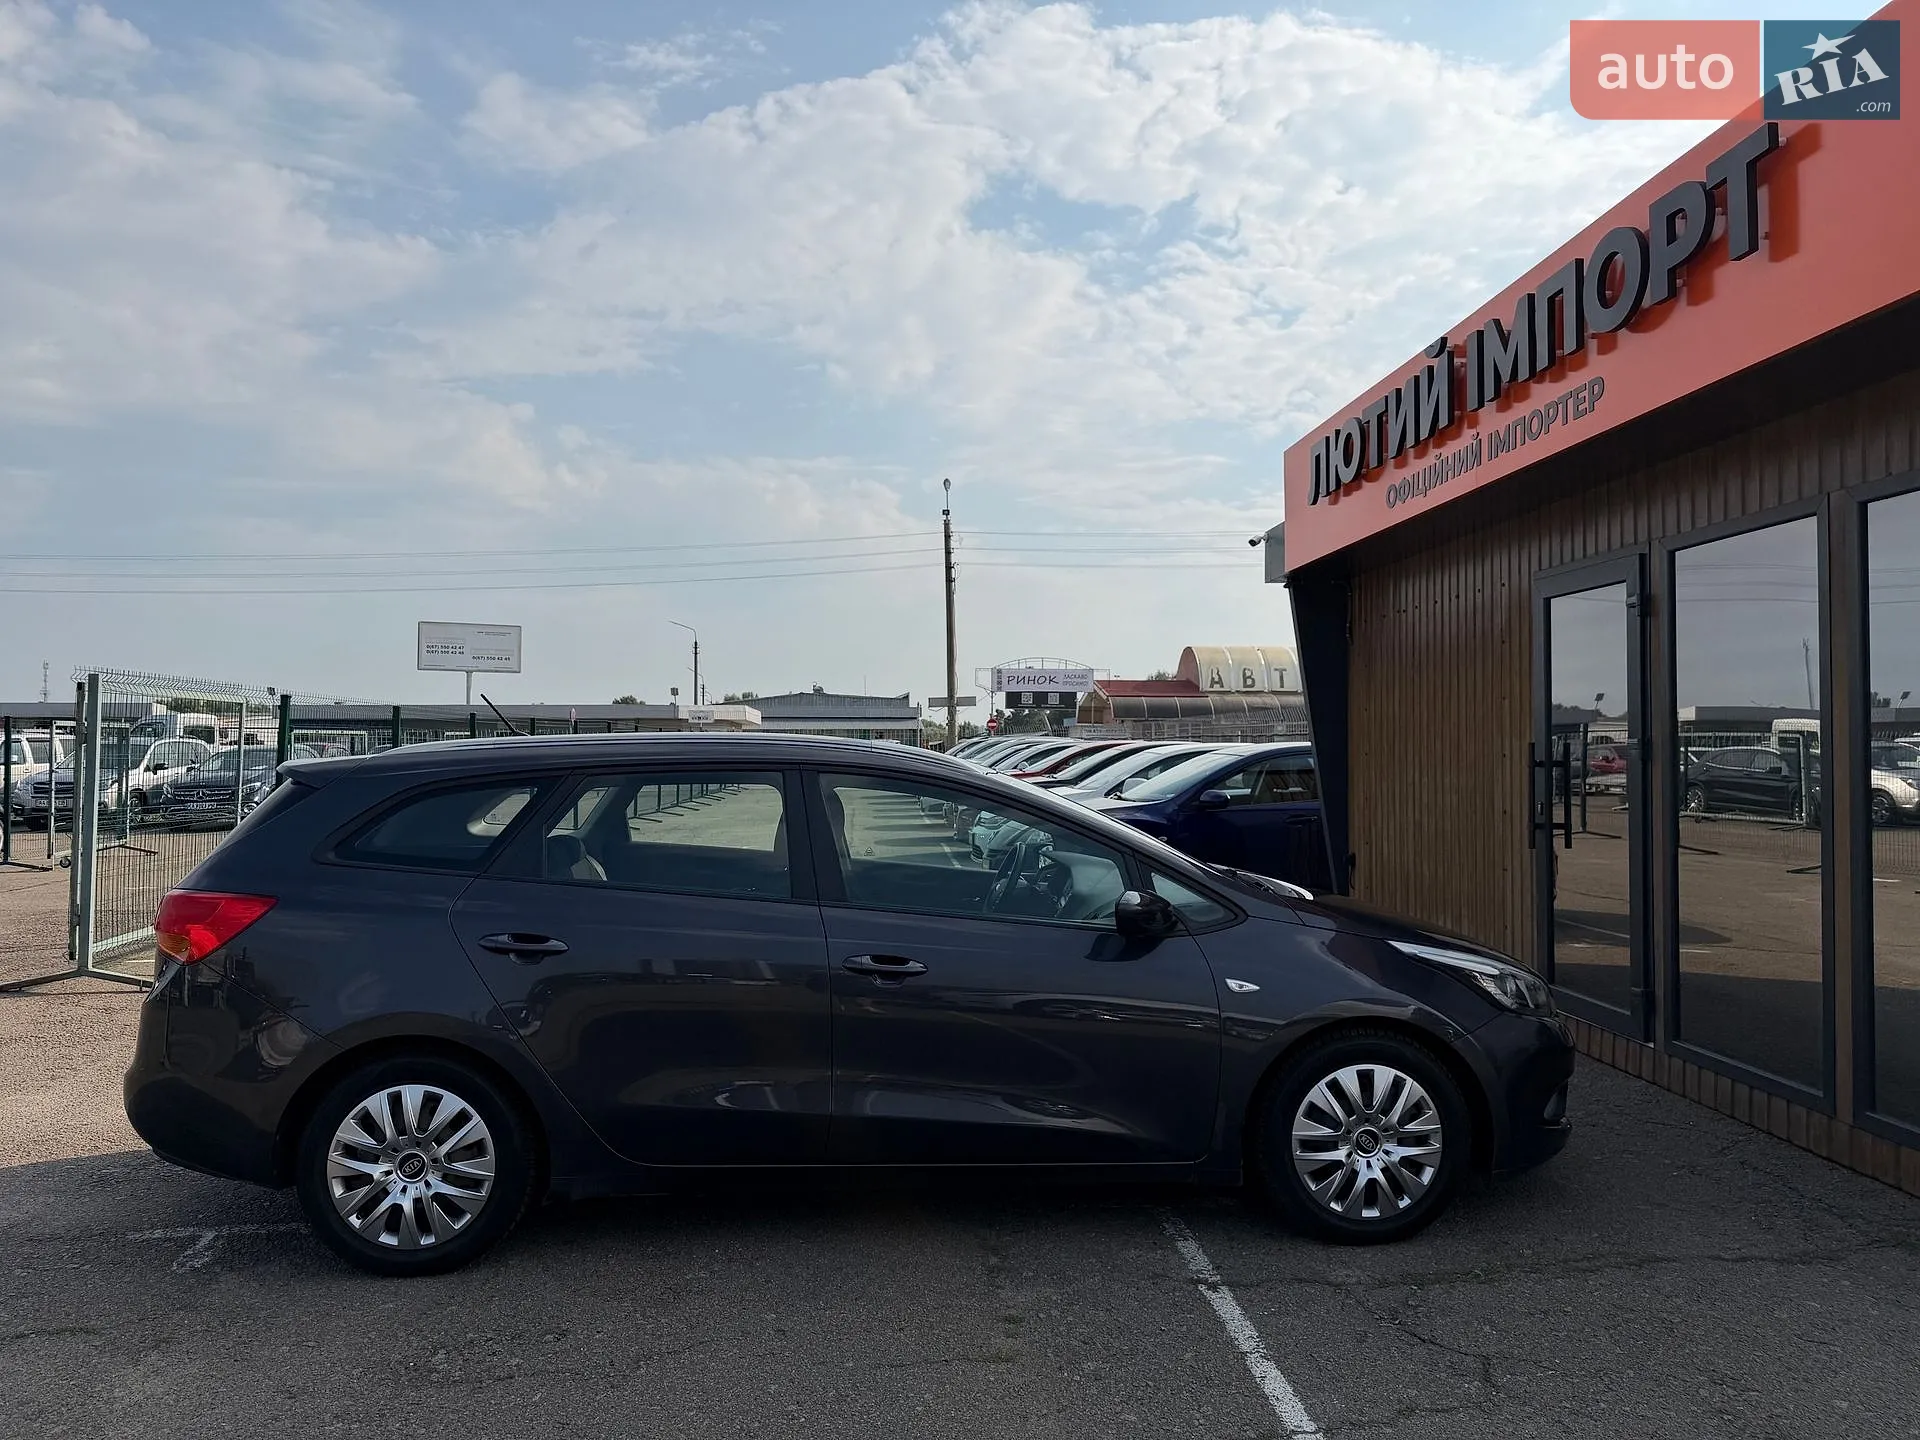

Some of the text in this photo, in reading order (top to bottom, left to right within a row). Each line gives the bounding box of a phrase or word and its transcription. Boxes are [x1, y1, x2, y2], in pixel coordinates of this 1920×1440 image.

[1308, 122, 1779, 505] ЛЮТИЙ ІМПОРТ
[1386, 376, 1605, 509] ОФІЦІЙНИЙ ІМПОРТЕР
[1006, 675, 1060, 686] РИНОК
